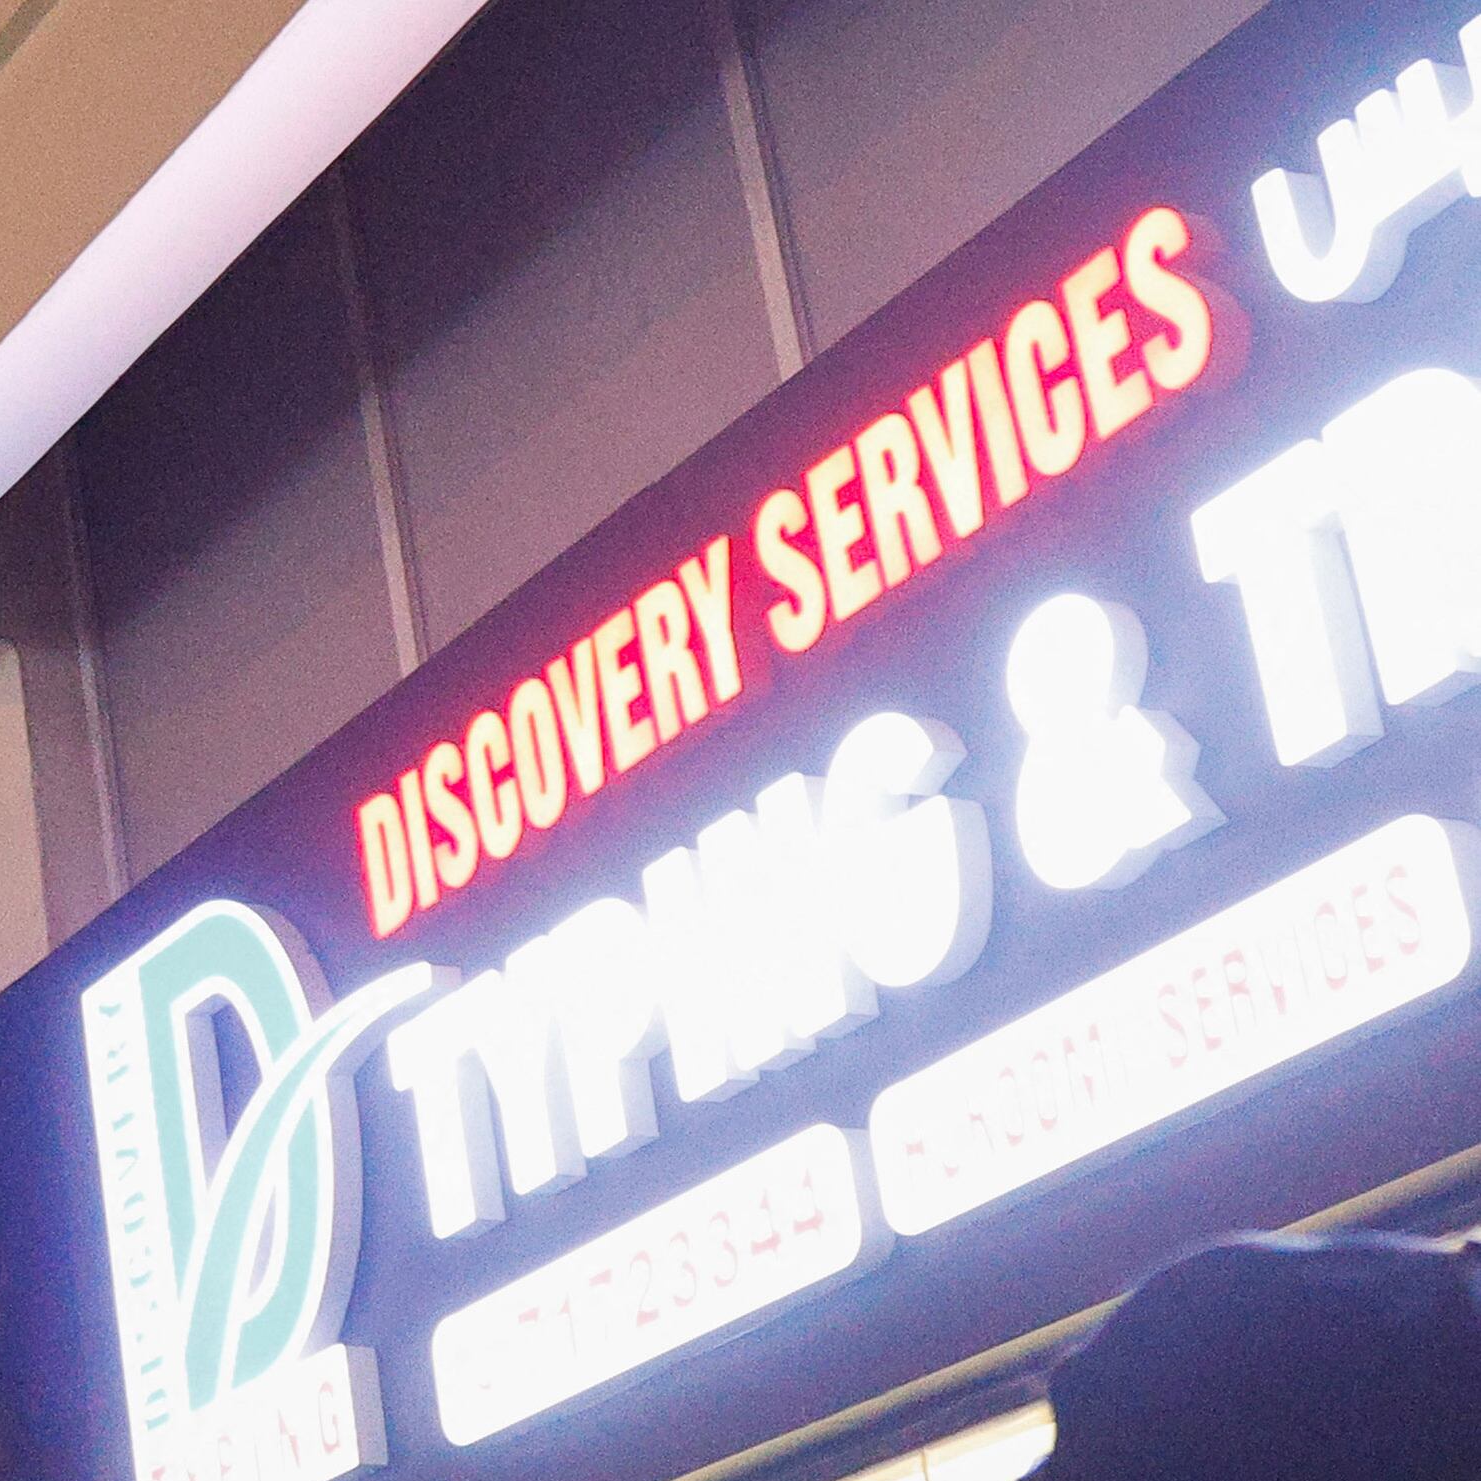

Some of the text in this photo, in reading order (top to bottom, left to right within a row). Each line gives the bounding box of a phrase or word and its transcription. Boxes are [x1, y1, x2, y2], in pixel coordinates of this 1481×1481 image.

[356, 205, 1214, 942] DISCOVERY SERVICES
[386, 712, 961, 1239] TYPING
[1006, 593, 1193, 889] &
[1157, 863, 1423, 1070] SERVICES
